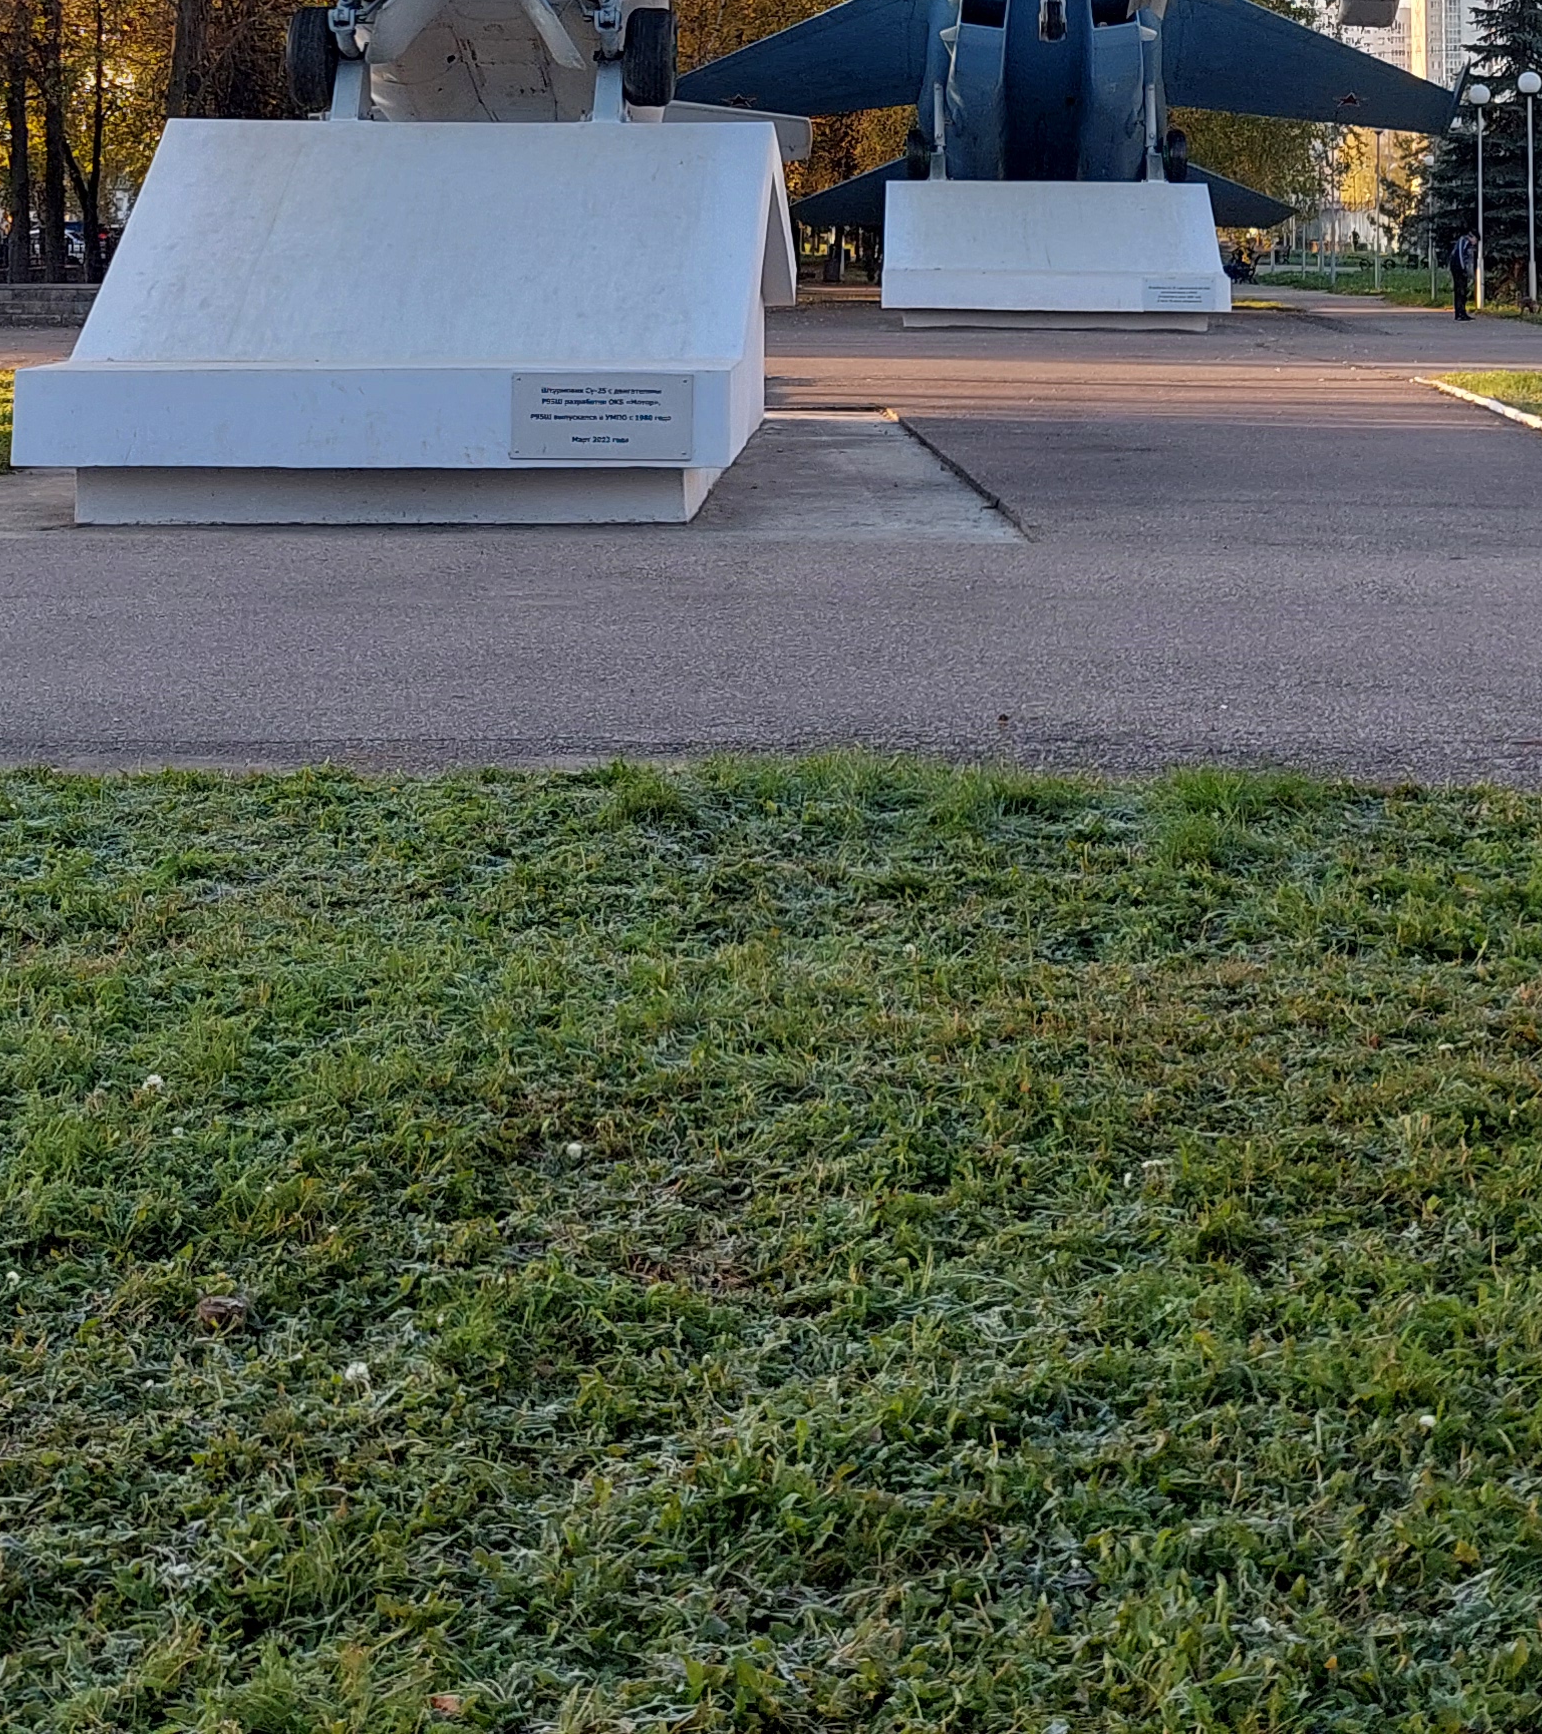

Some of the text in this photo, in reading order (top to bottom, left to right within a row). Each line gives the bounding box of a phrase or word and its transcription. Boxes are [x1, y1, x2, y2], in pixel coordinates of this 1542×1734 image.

[541, 387, 584, 395] Штурмовик
[585, 387, 607, 395] Су-25
[571, 436, 591, 444] Март
